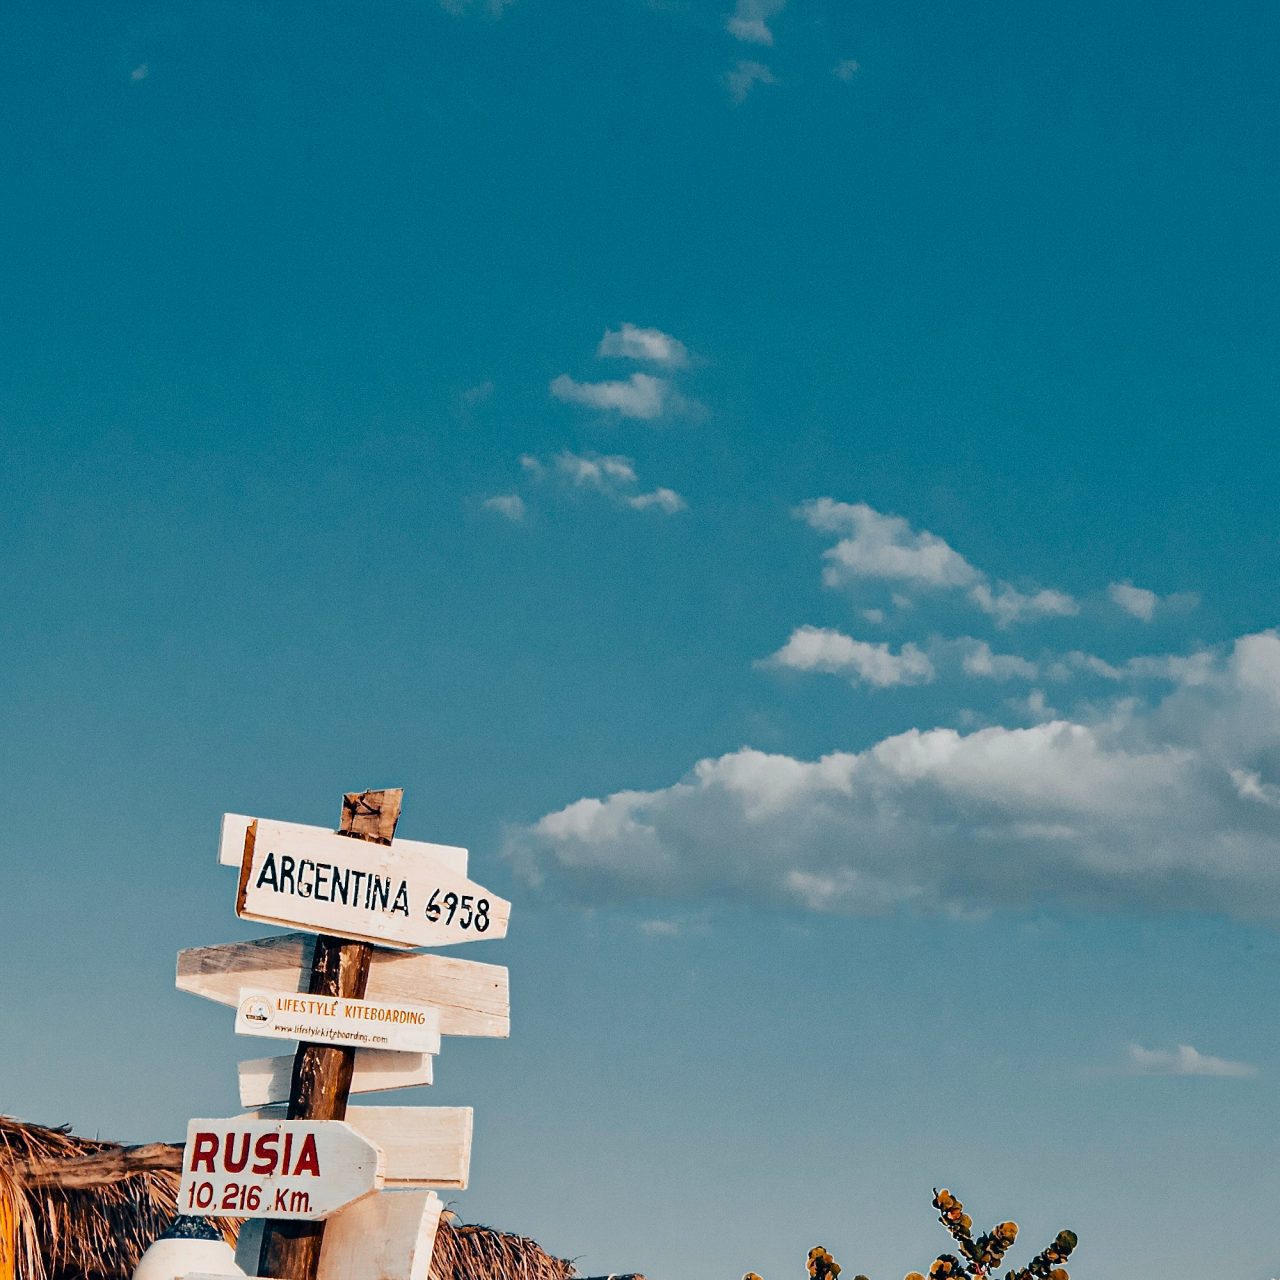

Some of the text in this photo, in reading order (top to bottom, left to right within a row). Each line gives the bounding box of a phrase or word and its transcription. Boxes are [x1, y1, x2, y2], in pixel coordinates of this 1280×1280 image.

[256, 852, 490, 932] ARGENTINA 6958
[344, 1007, 426, 1026] KITEBOARDING
[190, 1132, 321, 1177] RUSIA
[188, 1181, 262, 1211] 10,216
